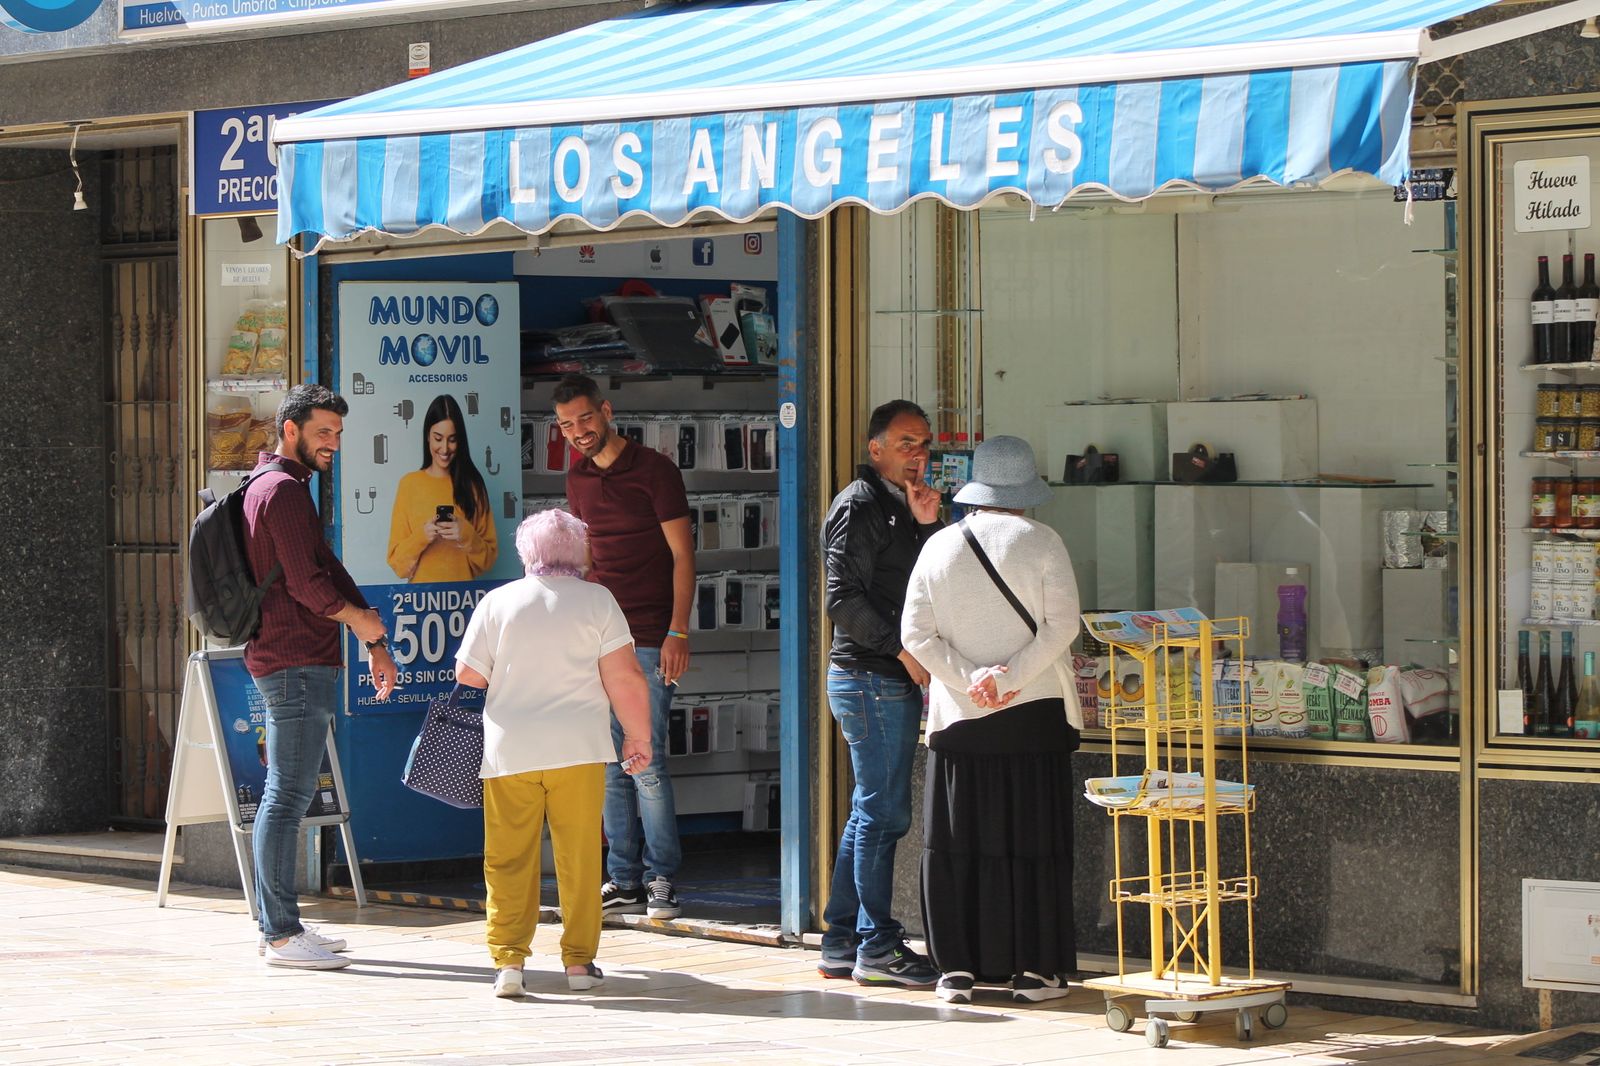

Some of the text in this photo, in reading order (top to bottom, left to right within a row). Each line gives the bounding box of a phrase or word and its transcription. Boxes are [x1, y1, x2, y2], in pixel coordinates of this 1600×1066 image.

[140, 8, 182, 25] Huelva
[193, 2, 228, 18] Punta
[509, 101, 1083, 204] LOS ANGELES
[1527, 170, 1578, 190] Huevo
[1525, 198, 1581, 220] Hilado
[368, 293, 500, 327] MUNDO
[378, 333, 490, 367] MOVIL
[408, 373, 468, 383] ACCESORIOS
[415, 670, 435, 683] SIN
[398, 692, 432, 704] SEVILLA
